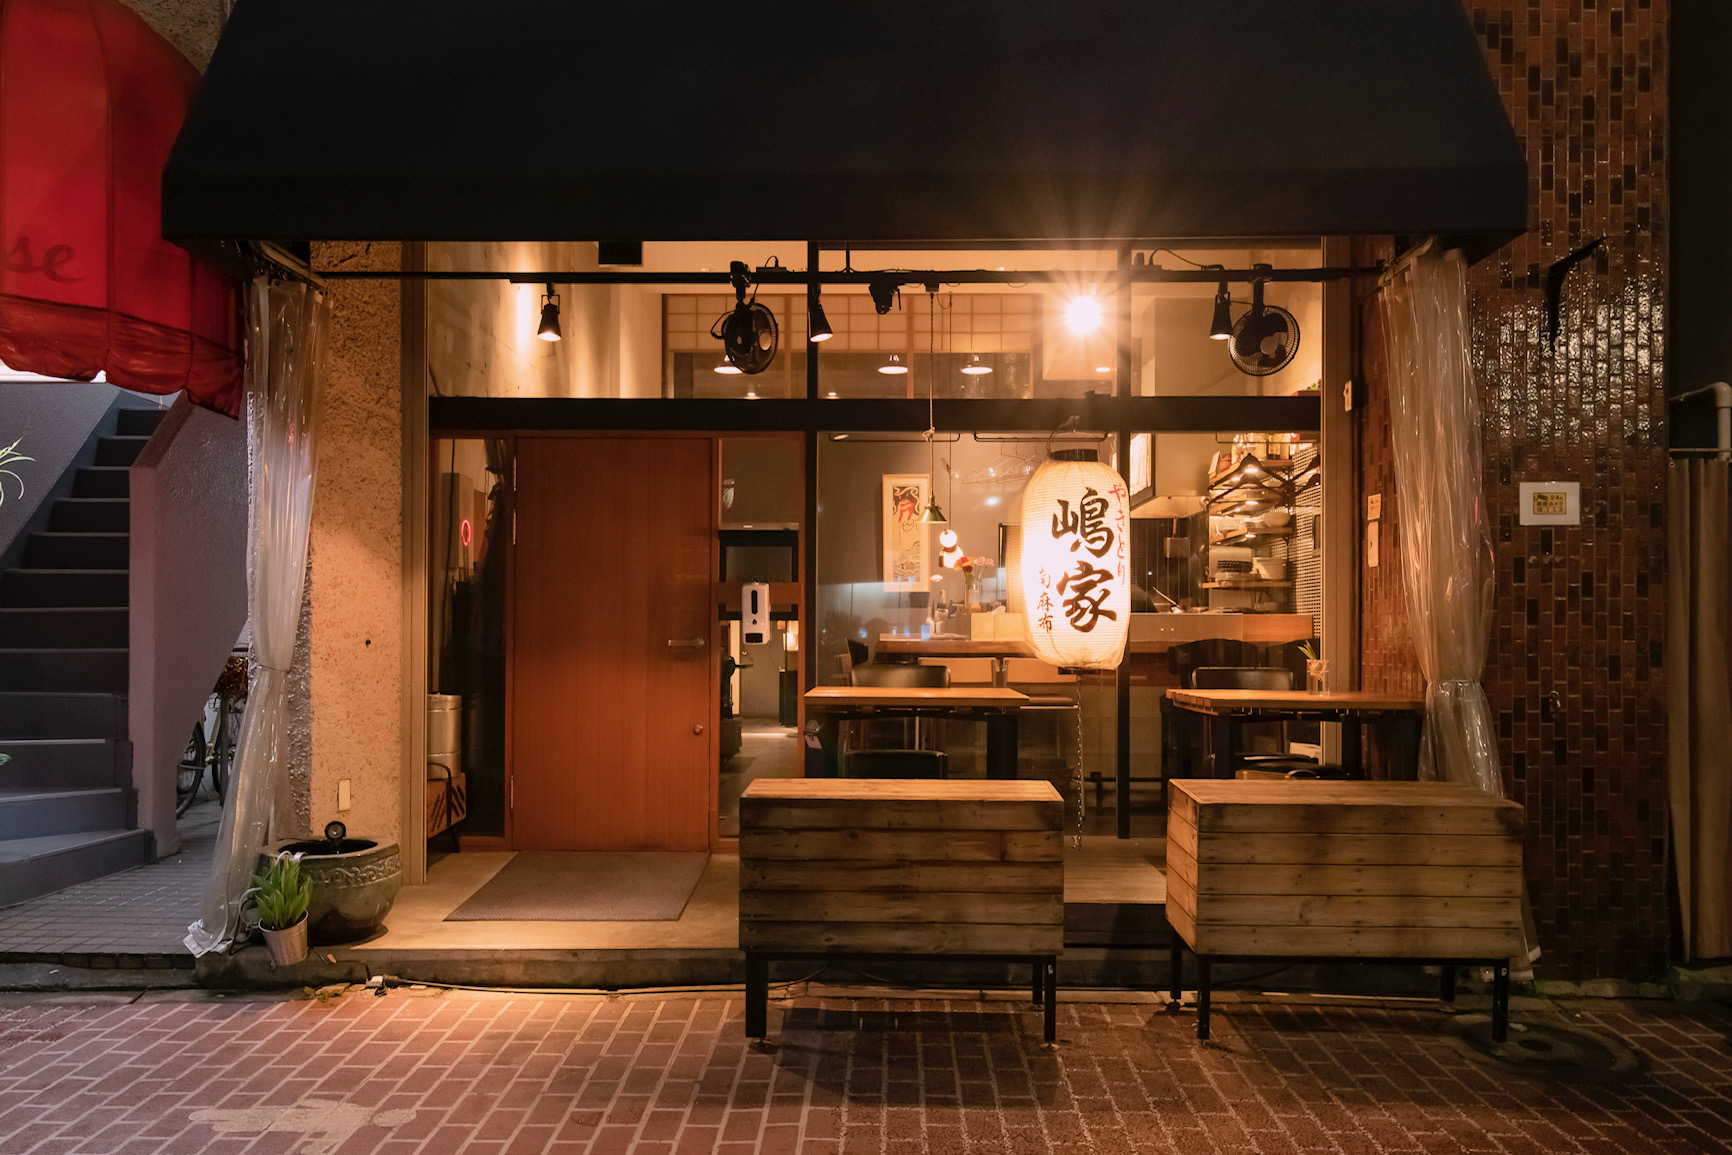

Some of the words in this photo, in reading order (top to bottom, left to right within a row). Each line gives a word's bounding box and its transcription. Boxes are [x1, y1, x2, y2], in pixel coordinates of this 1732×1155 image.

[1051, 486, 1117, 633] 嶋家
[1107, 483, 1127, 586] やきとり
[1036, 565, 1054, 634] 南麻布
